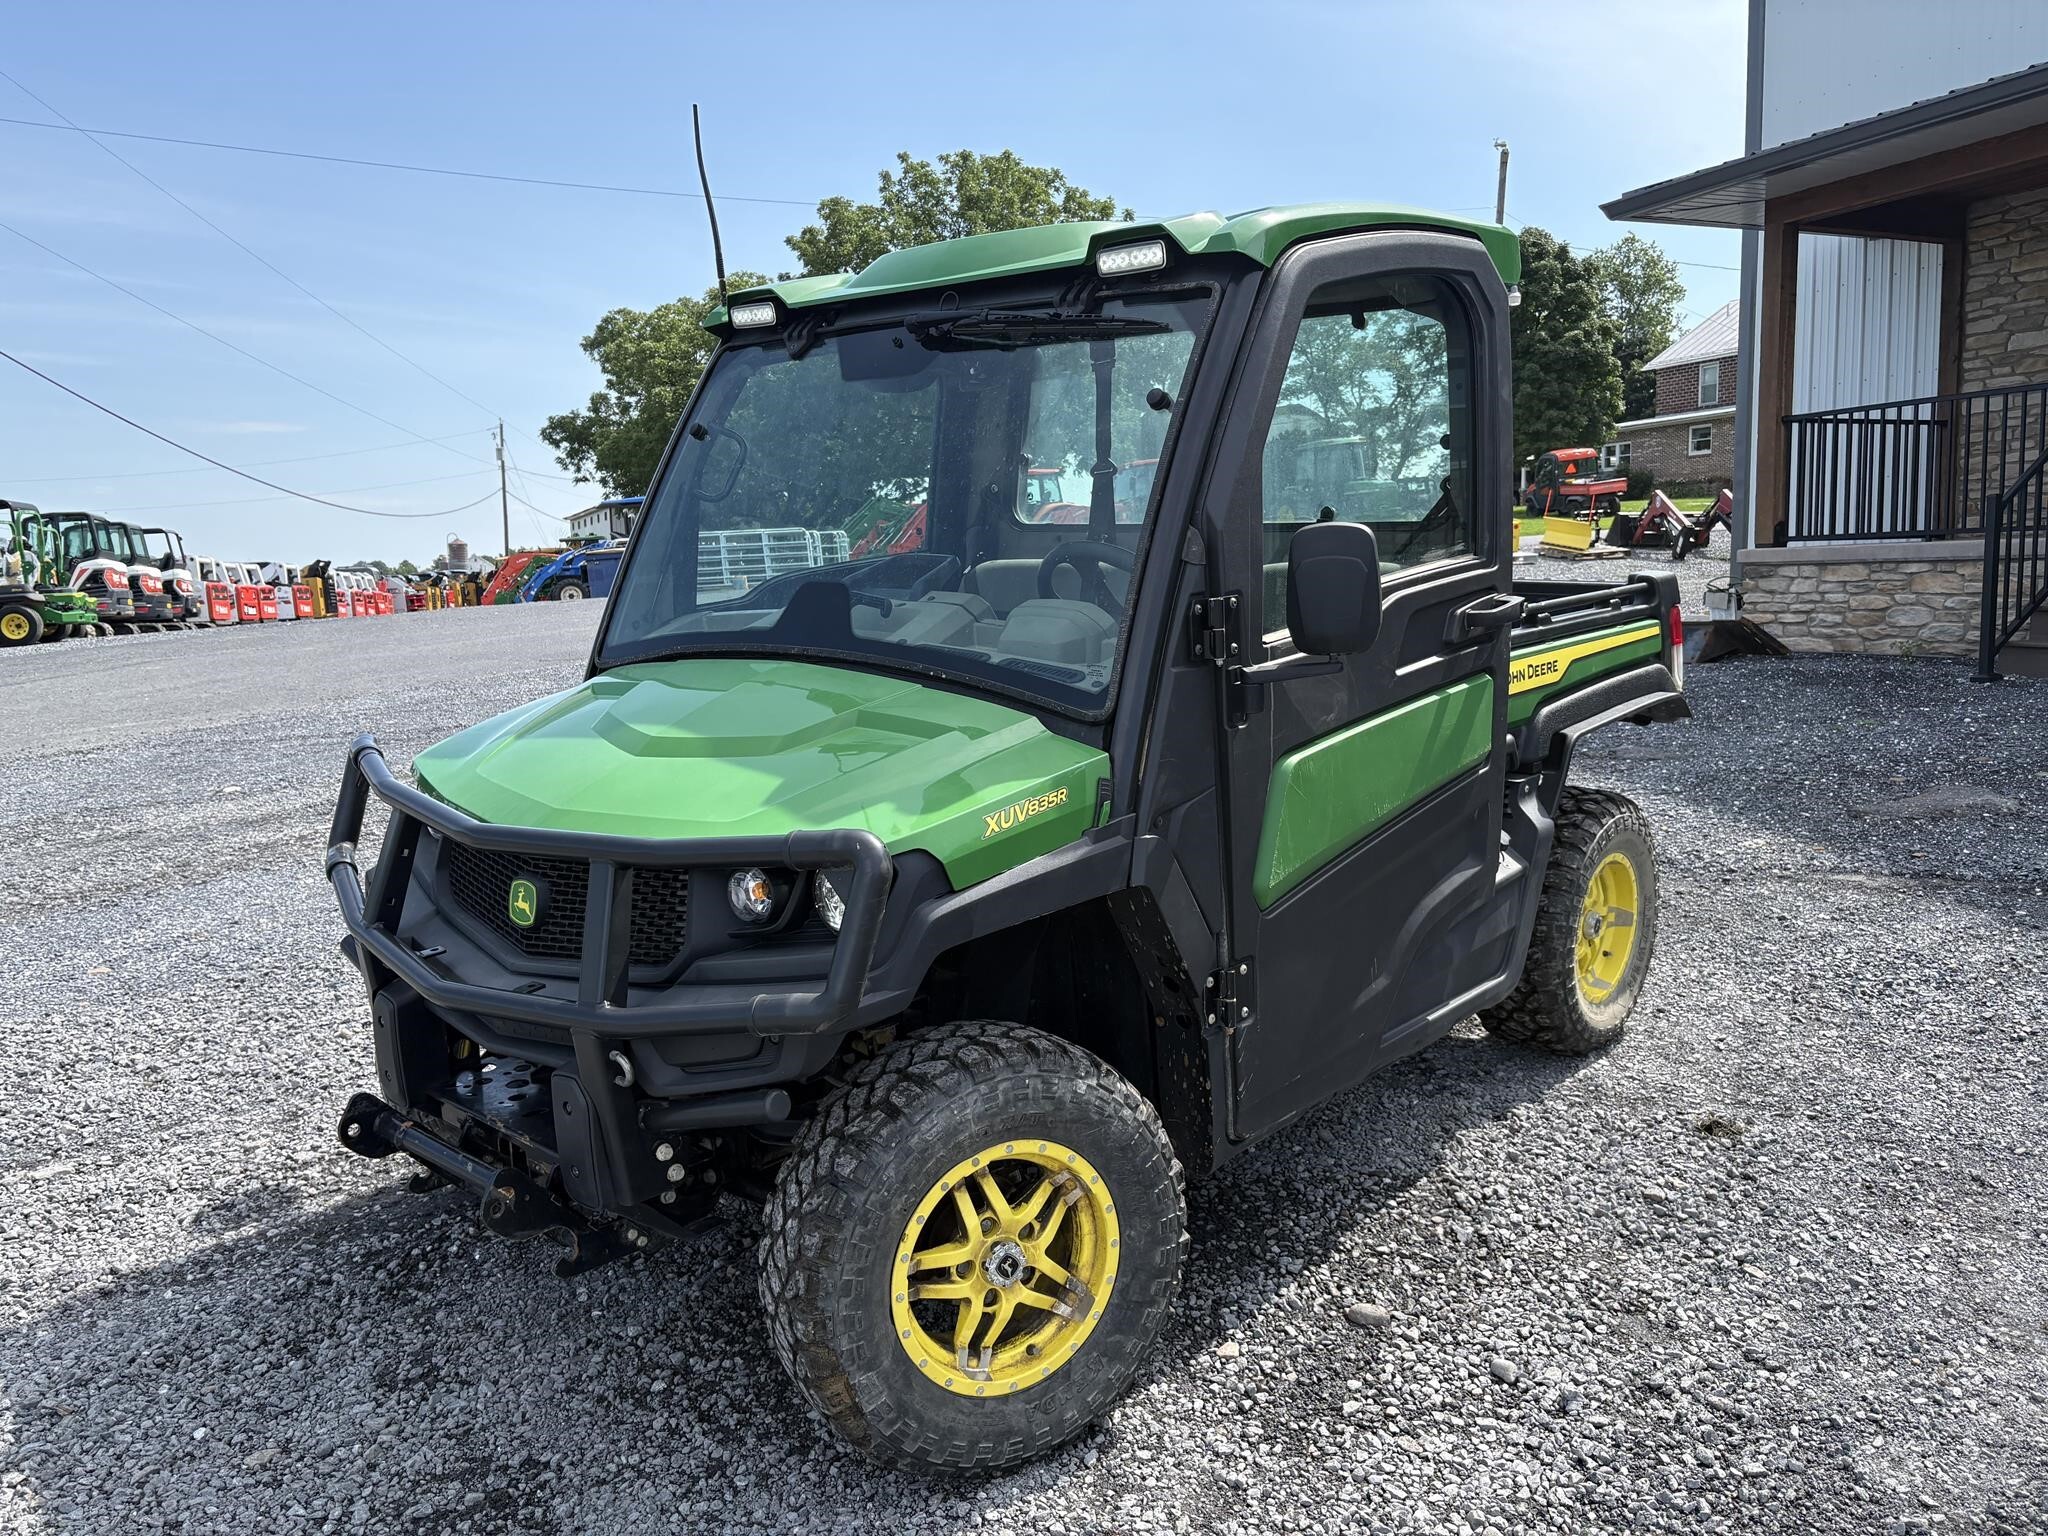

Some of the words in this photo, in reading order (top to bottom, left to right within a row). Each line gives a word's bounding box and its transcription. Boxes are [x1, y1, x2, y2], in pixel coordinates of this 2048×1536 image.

[1508, 668, 1526, 684] HN
[1527, 660, 1558, 680] DEERE
[983, 788, 1067, 838] XUV835R
